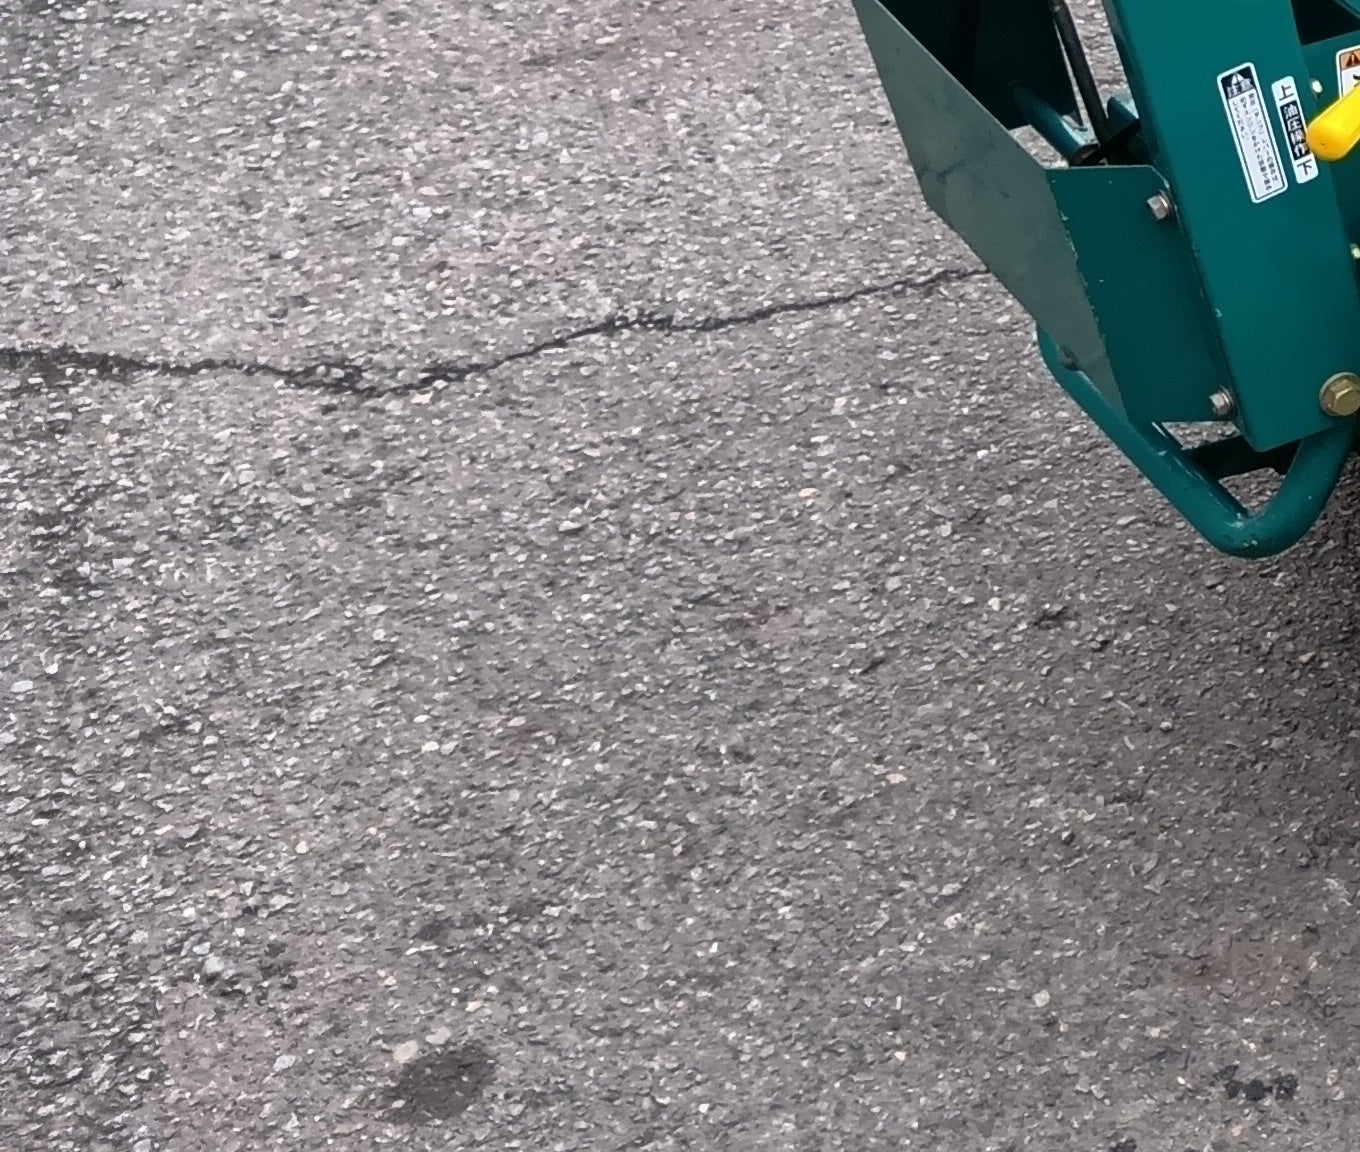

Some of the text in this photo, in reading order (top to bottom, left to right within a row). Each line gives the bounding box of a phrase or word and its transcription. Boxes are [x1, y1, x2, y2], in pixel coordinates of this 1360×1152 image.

[1278, 84, 1314, 176] 上 油圧操作 下
